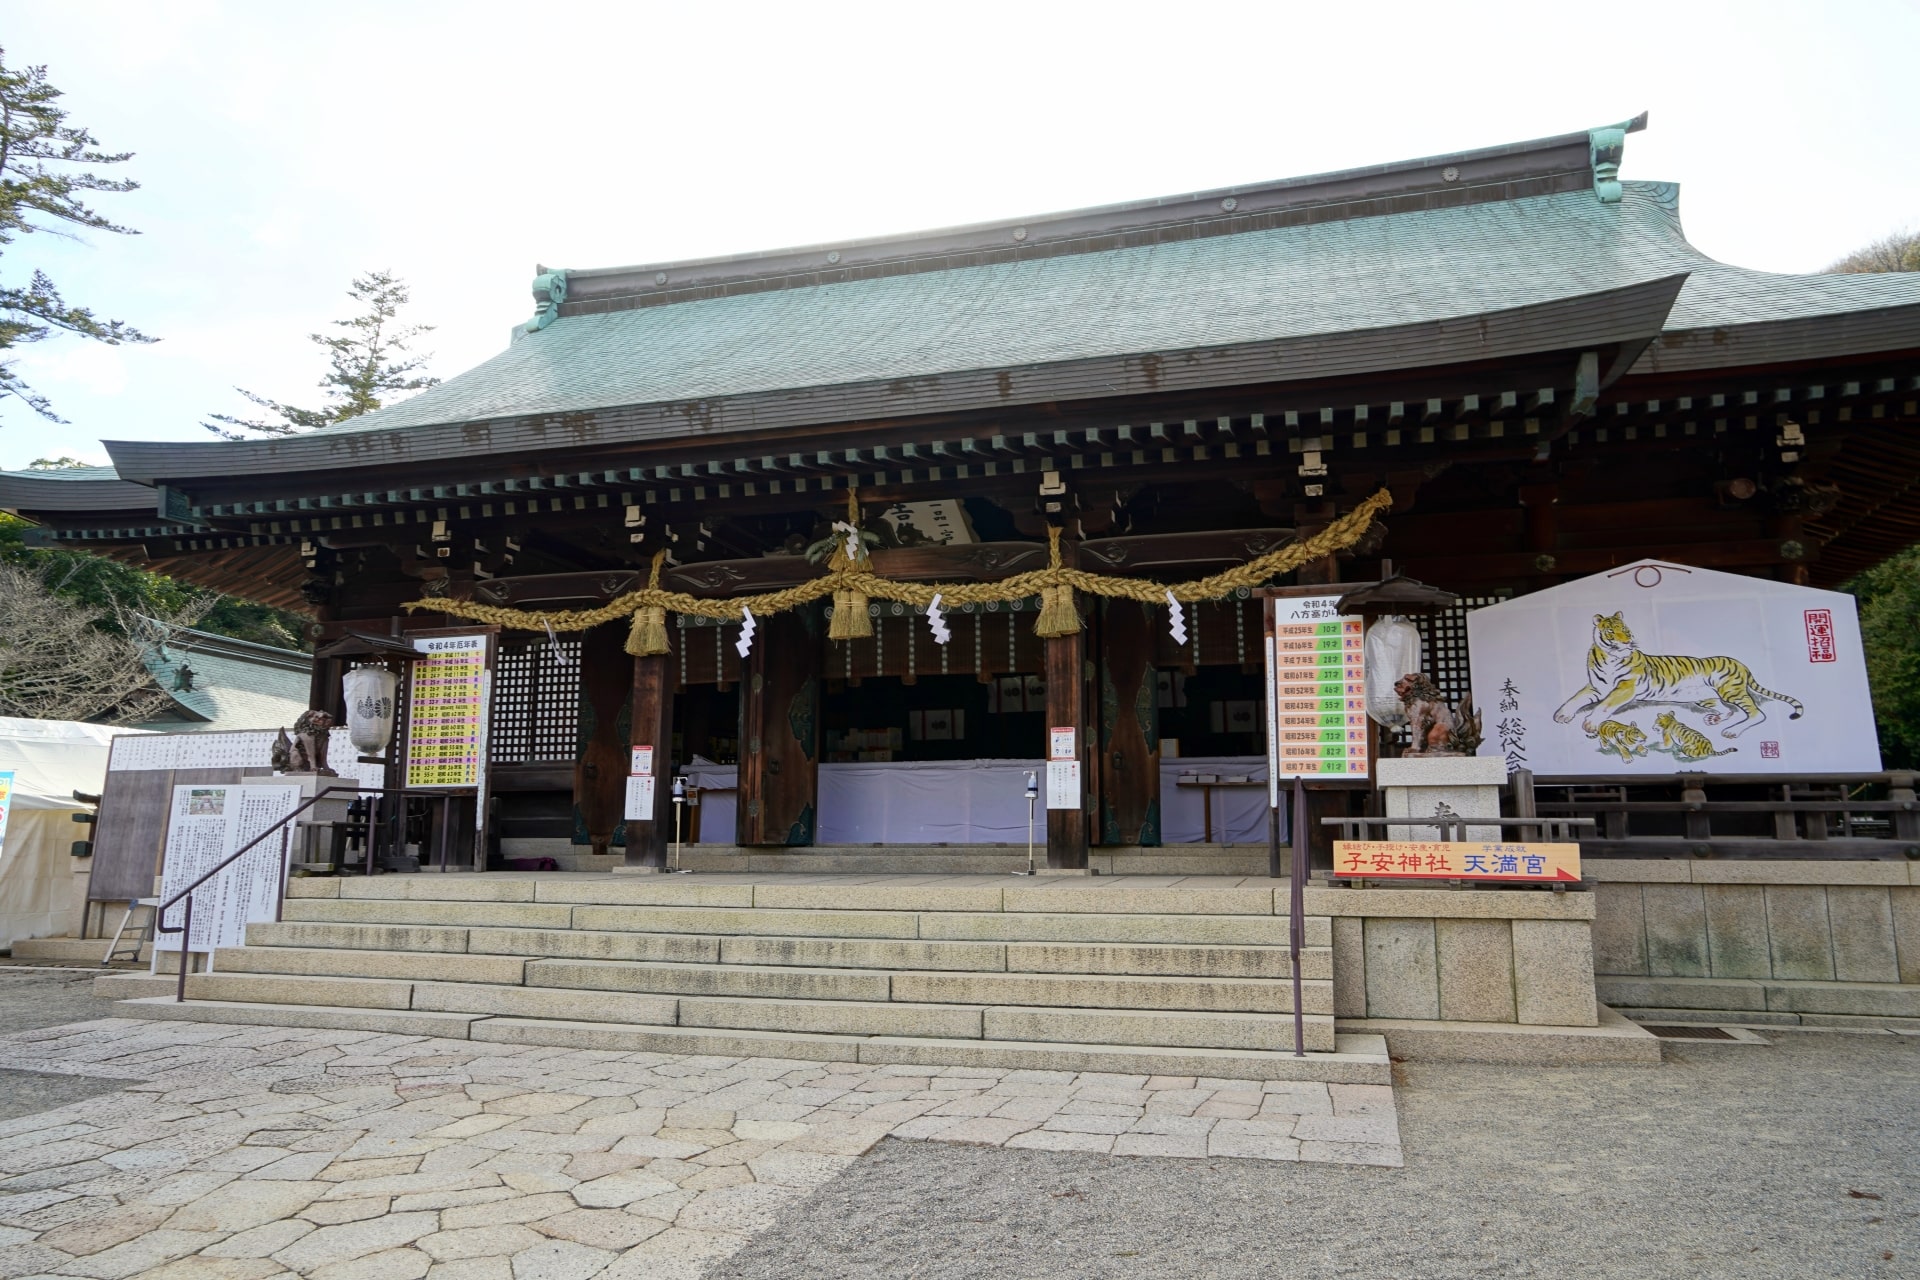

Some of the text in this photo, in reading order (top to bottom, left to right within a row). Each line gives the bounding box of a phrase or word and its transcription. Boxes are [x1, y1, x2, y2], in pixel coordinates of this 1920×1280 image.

[1303, 600, 1336, 608] 令和4年
[1291, 609, 1349, 619] 八方塞がり
[1808, 613, 1833, 660] 開運招福
[1283, 656, 1314, 664] 平成7年生
[1499, 678, 1520, 712] 奉納
[1482, 844, 1527, 853] 学業成就
[1342, 852, 1546, 874] 子安神社 天満宮
